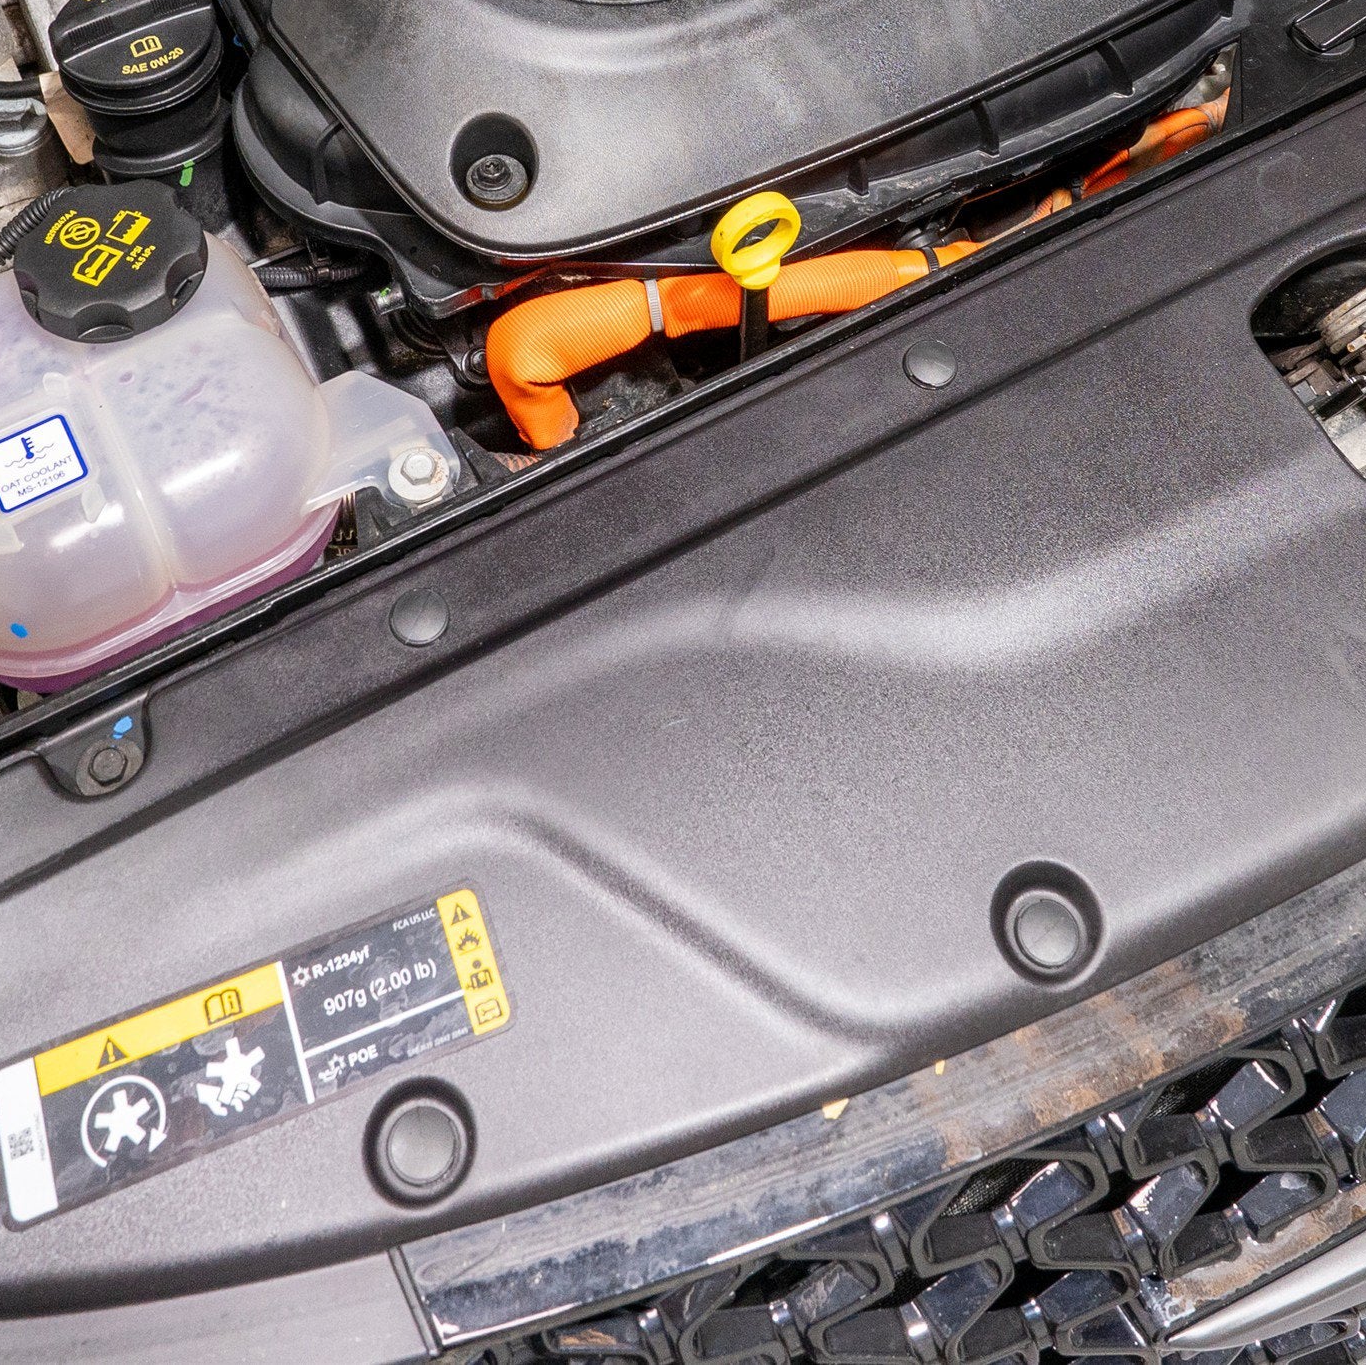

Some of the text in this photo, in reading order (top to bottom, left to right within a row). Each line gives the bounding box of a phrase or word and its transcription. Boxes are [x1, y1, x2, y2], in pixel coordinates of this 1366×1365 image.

[121, 47, 184, 75] SAE 0W-20
[1, 455, 73, 494] OAT COOLANT
[17, 470, 66, 498] MS-12106
[392, 907, 436, 932] FCA US LLC
[311, 945, 371, 980] R-1234yf
[323, 958, 438, 1016] 907g (2.00 lb)
[348, 1043, 379, 1068] POE
